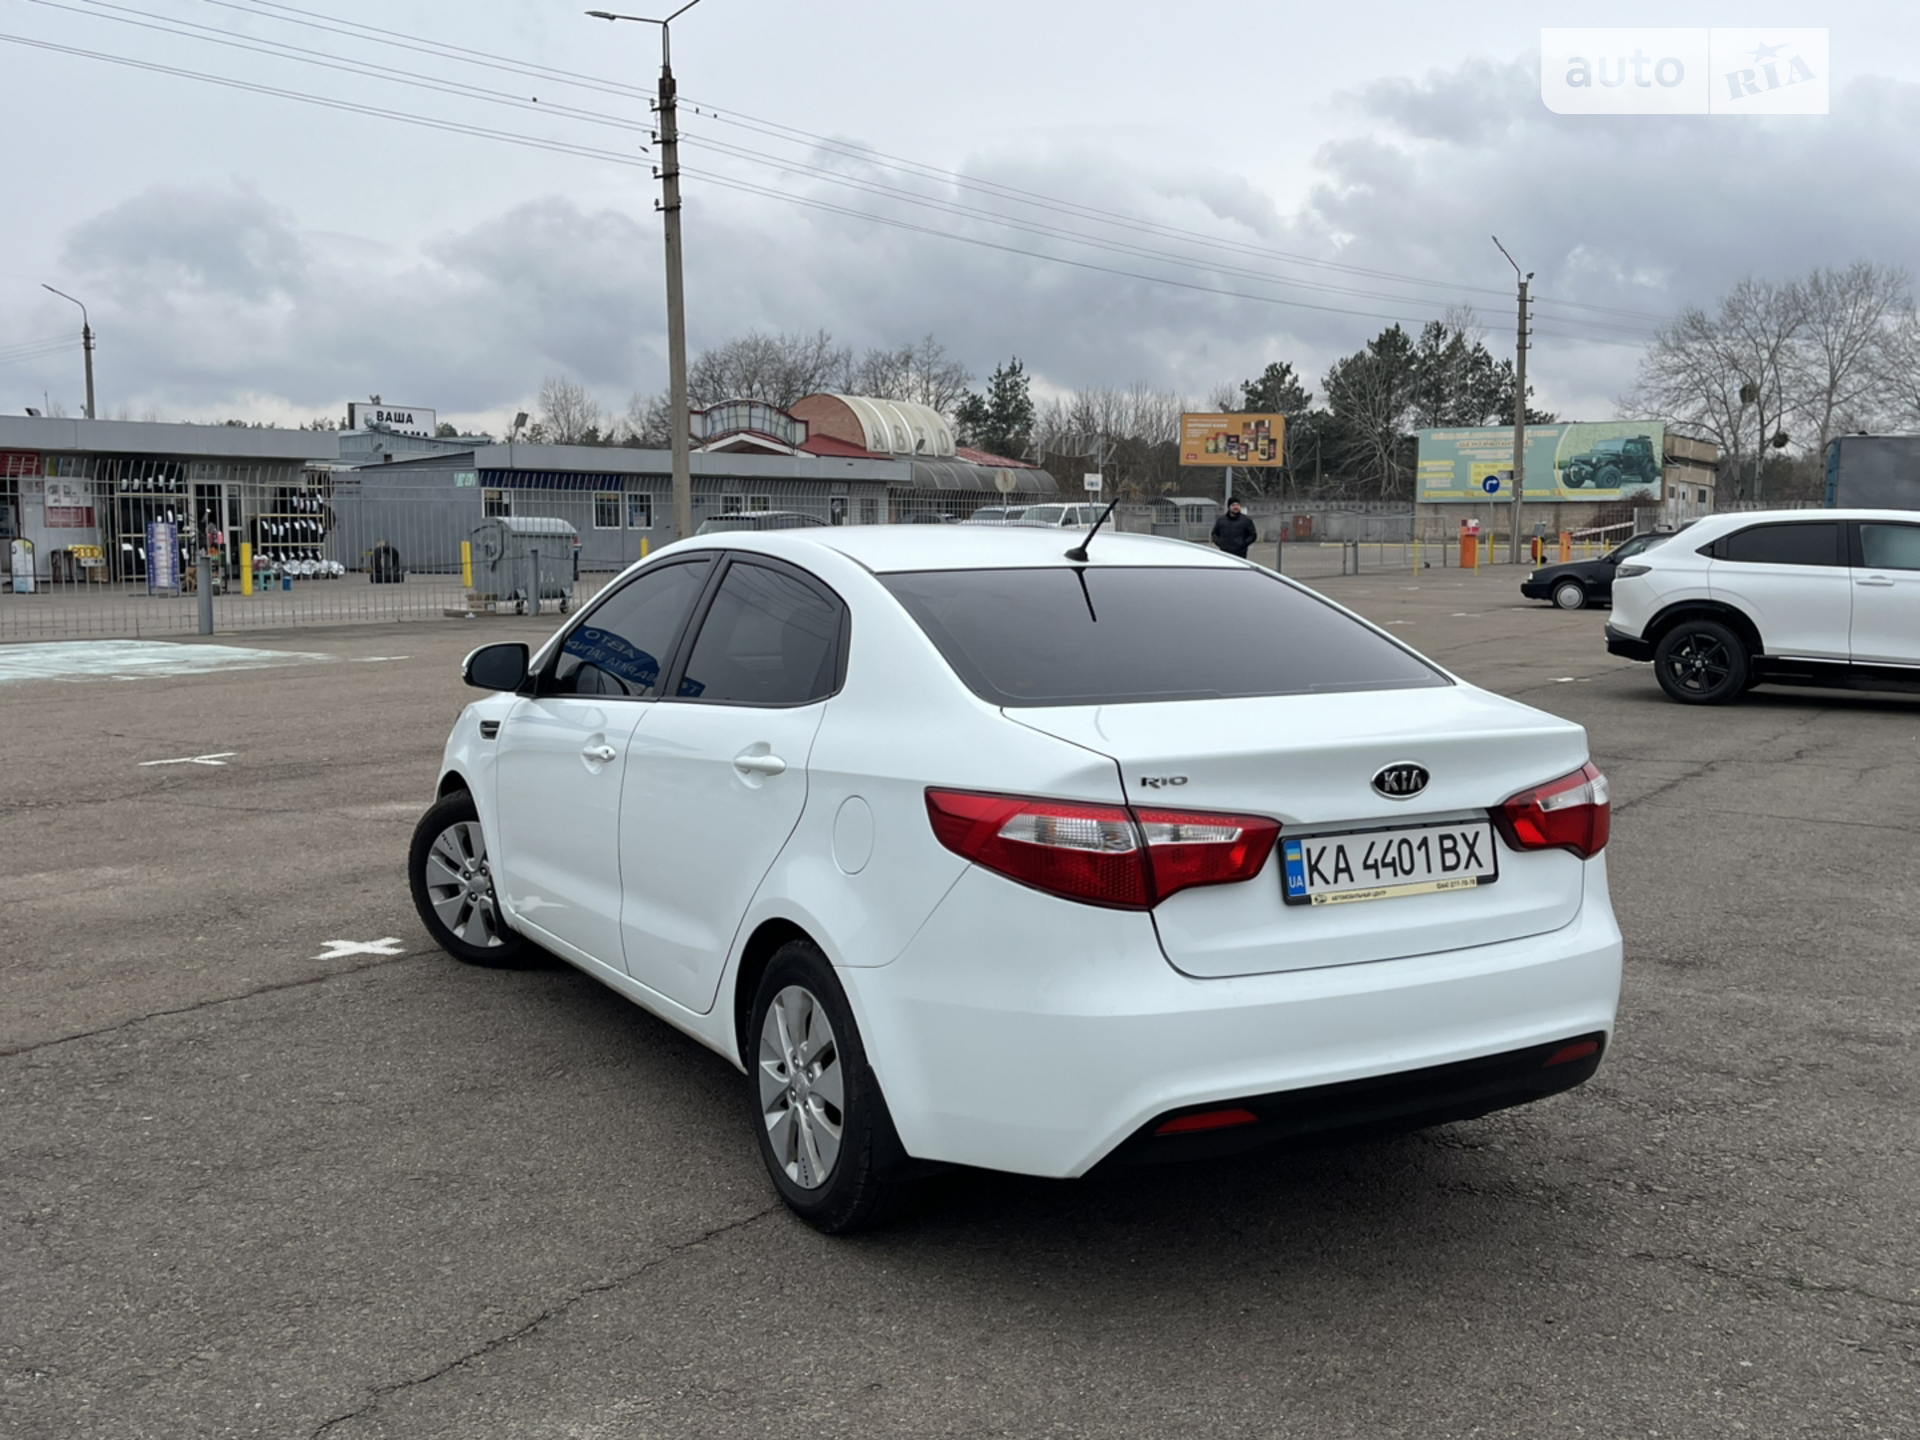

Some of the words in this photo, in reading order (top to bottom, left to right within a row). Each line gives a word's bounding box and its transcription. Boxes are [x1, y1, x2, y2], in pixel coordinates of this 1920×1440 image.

[376, 410, 414, 425] ВАША
[1141, 776, 1189, 789] RIO
[1384, 769, 1423, 791] KIA
[1306, 844, 1354, 887] KA
[1362, 836, 1432, 880] 4401
[1438, 831, 1484, 872] BX
[1288, 875, 1304, 889] UA
